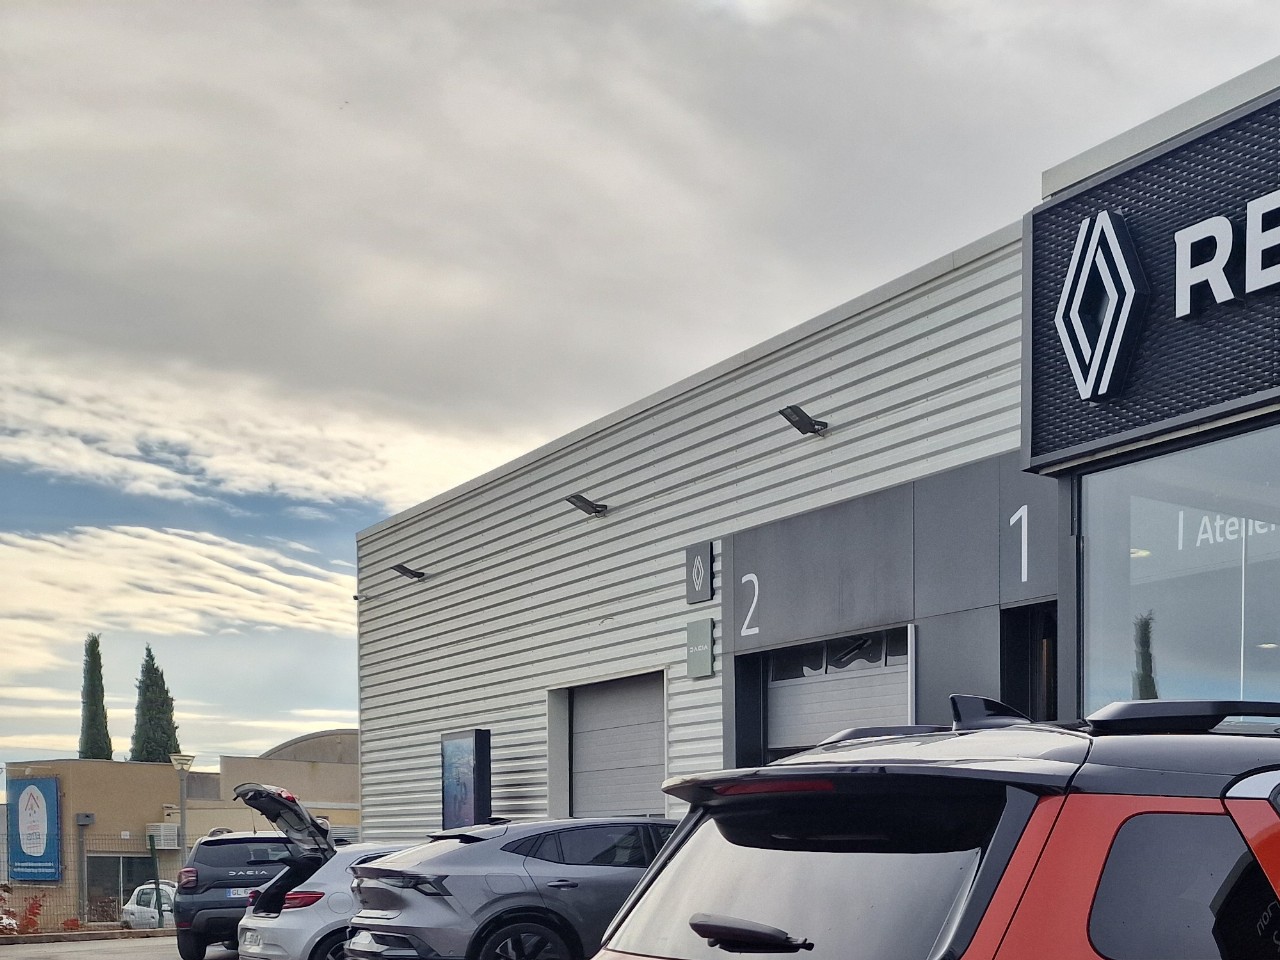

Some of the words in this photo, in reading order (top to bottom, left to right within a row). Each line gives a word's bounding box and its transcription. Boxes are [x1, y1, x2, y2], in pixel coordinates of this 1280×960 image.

[1008, 504, 1028, 583] 1
[1196, 514, 1276, 547] Atelie
[739, 572, 760, 637] 2
